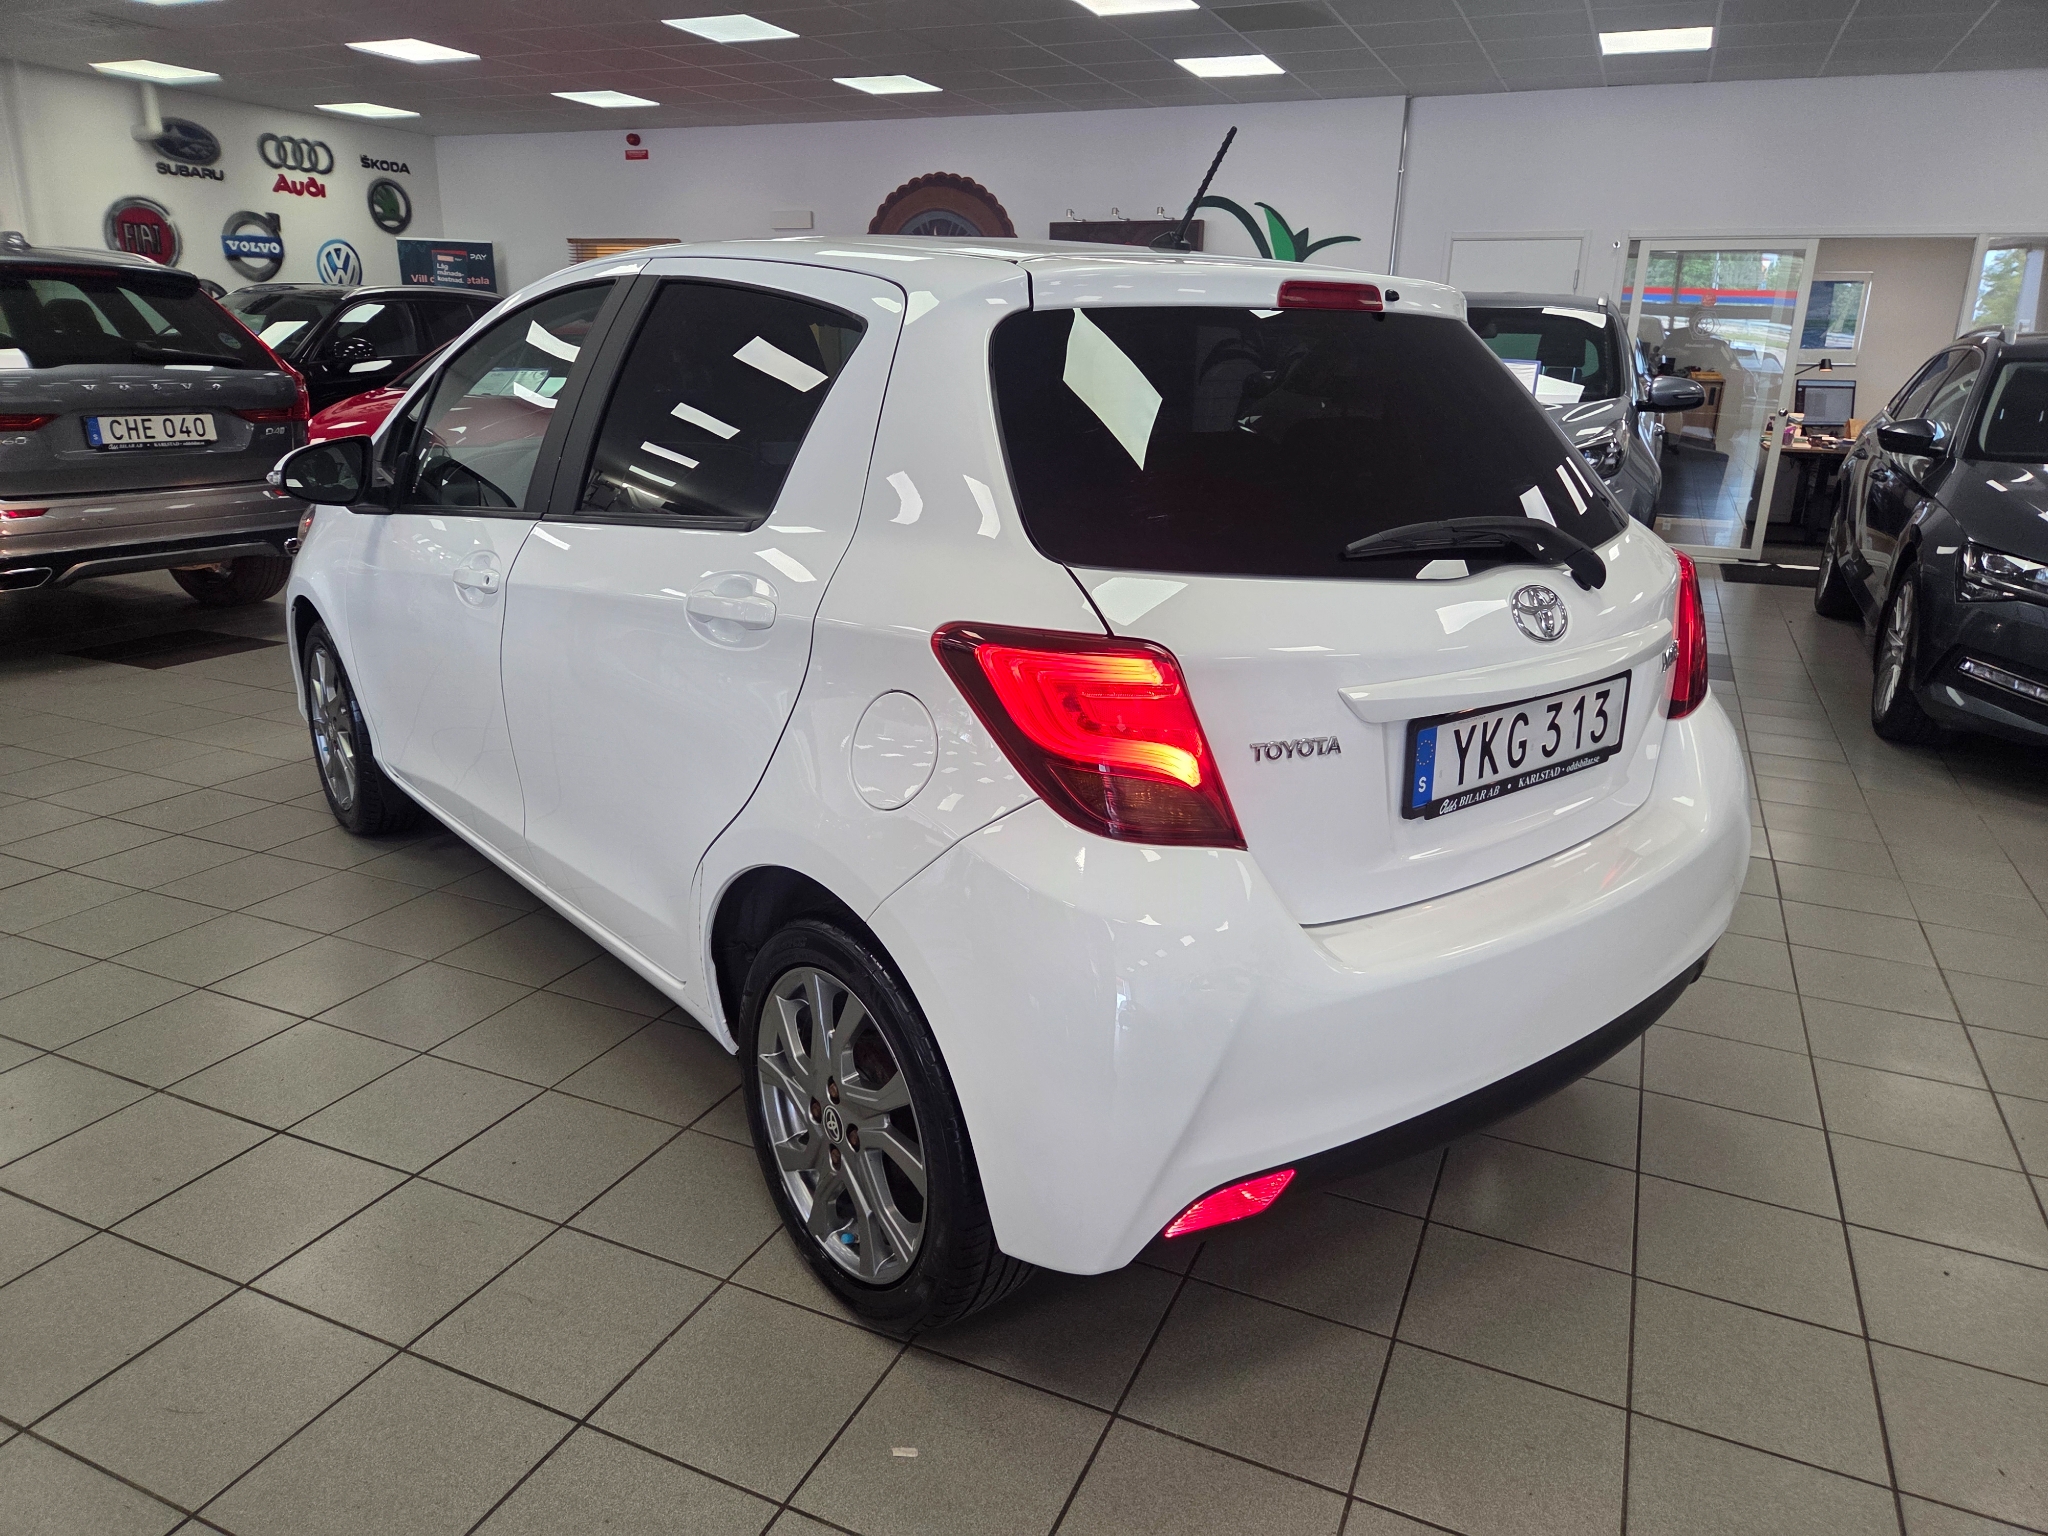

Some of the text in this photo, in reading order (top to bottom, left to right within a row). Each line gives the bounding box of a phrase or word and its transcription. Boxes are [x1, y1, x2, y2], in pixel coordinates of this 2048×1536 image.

[156, 161, 224, 181] SUBARU
[361, 154, 411, 175] ŠKODA
[272, 173, 327, 198] Audi
[121, 223, 162, 255] FIAT
[225, 239, 281, 254] VOLVO
[469, 253, 487, 261] PAY
[410, 274, 428, 283] Vill
[109, 416, 206, 441] CHE 040
[1453, 688, 1611, 786] YKG 313
[1249, 735, 1342, 763] TOYOTA
[1417, 776, 1428, 793] S
[1458, 789, 1487, 807] BILAR
[1486, 785, 1501, 798] AB
[1518, 766, 1561, 788] KARLSTAD
